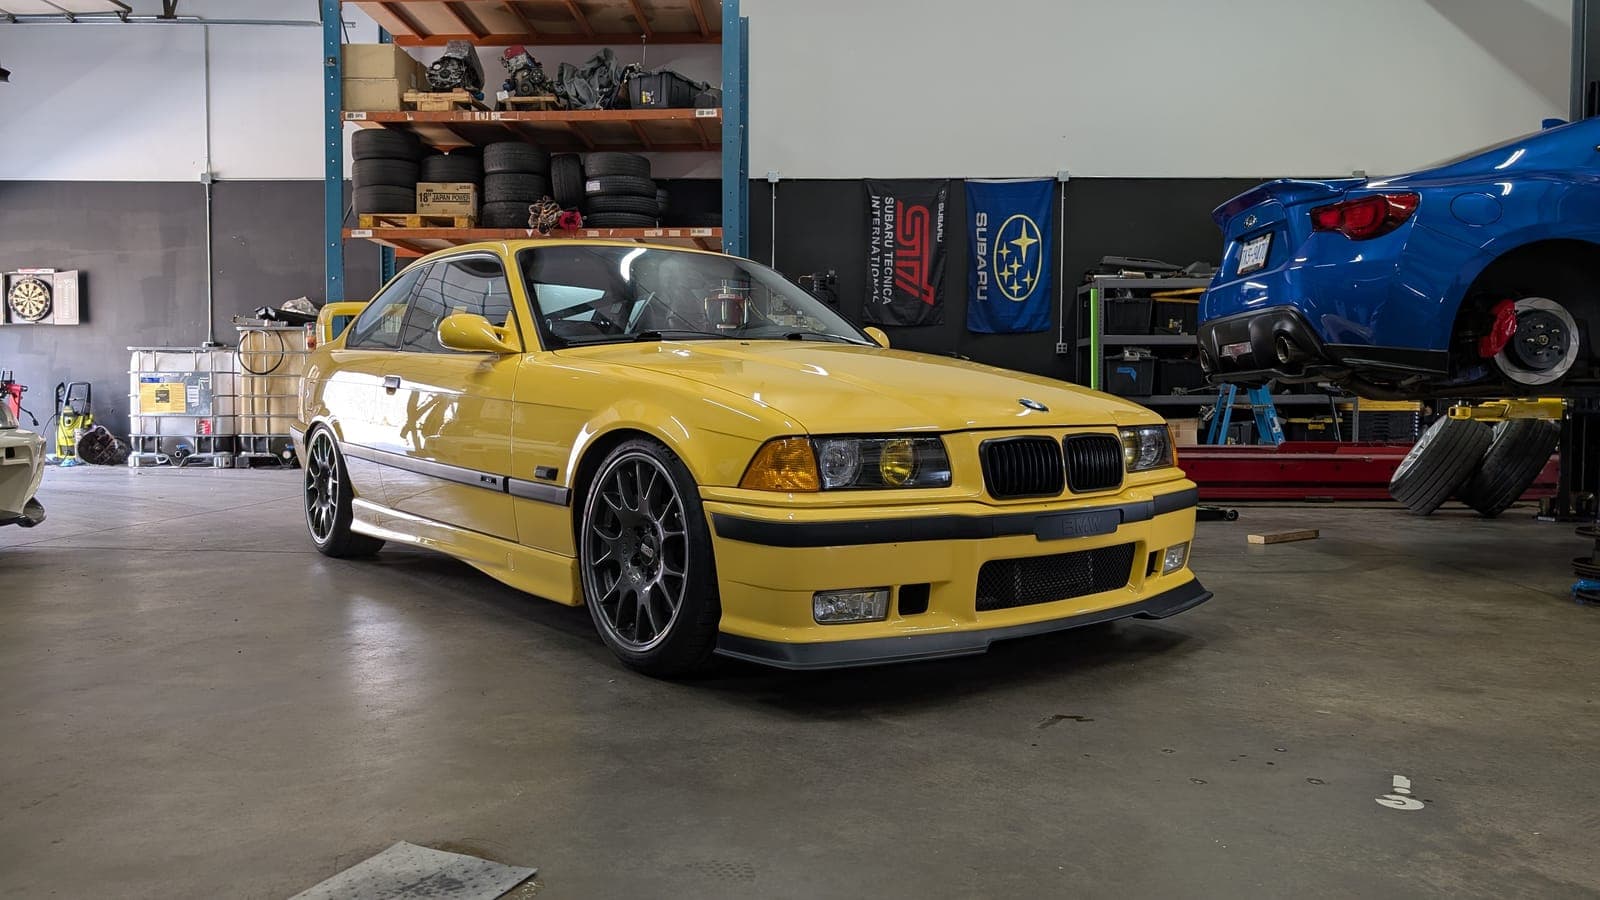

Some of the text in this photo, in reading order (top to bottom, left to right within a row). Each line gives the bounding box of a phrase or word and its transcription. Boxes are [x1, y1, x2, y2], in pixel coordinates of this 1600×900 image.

[870, 195, 881, 303] INTERNATIONAL
[882, 196, 895, 305] SUBARU TECNICA
[937, 202, 945, 243] SUBARU
[975, 211, 988, 301] SUBARU
[1062, 516, 1101, 536] BMW
